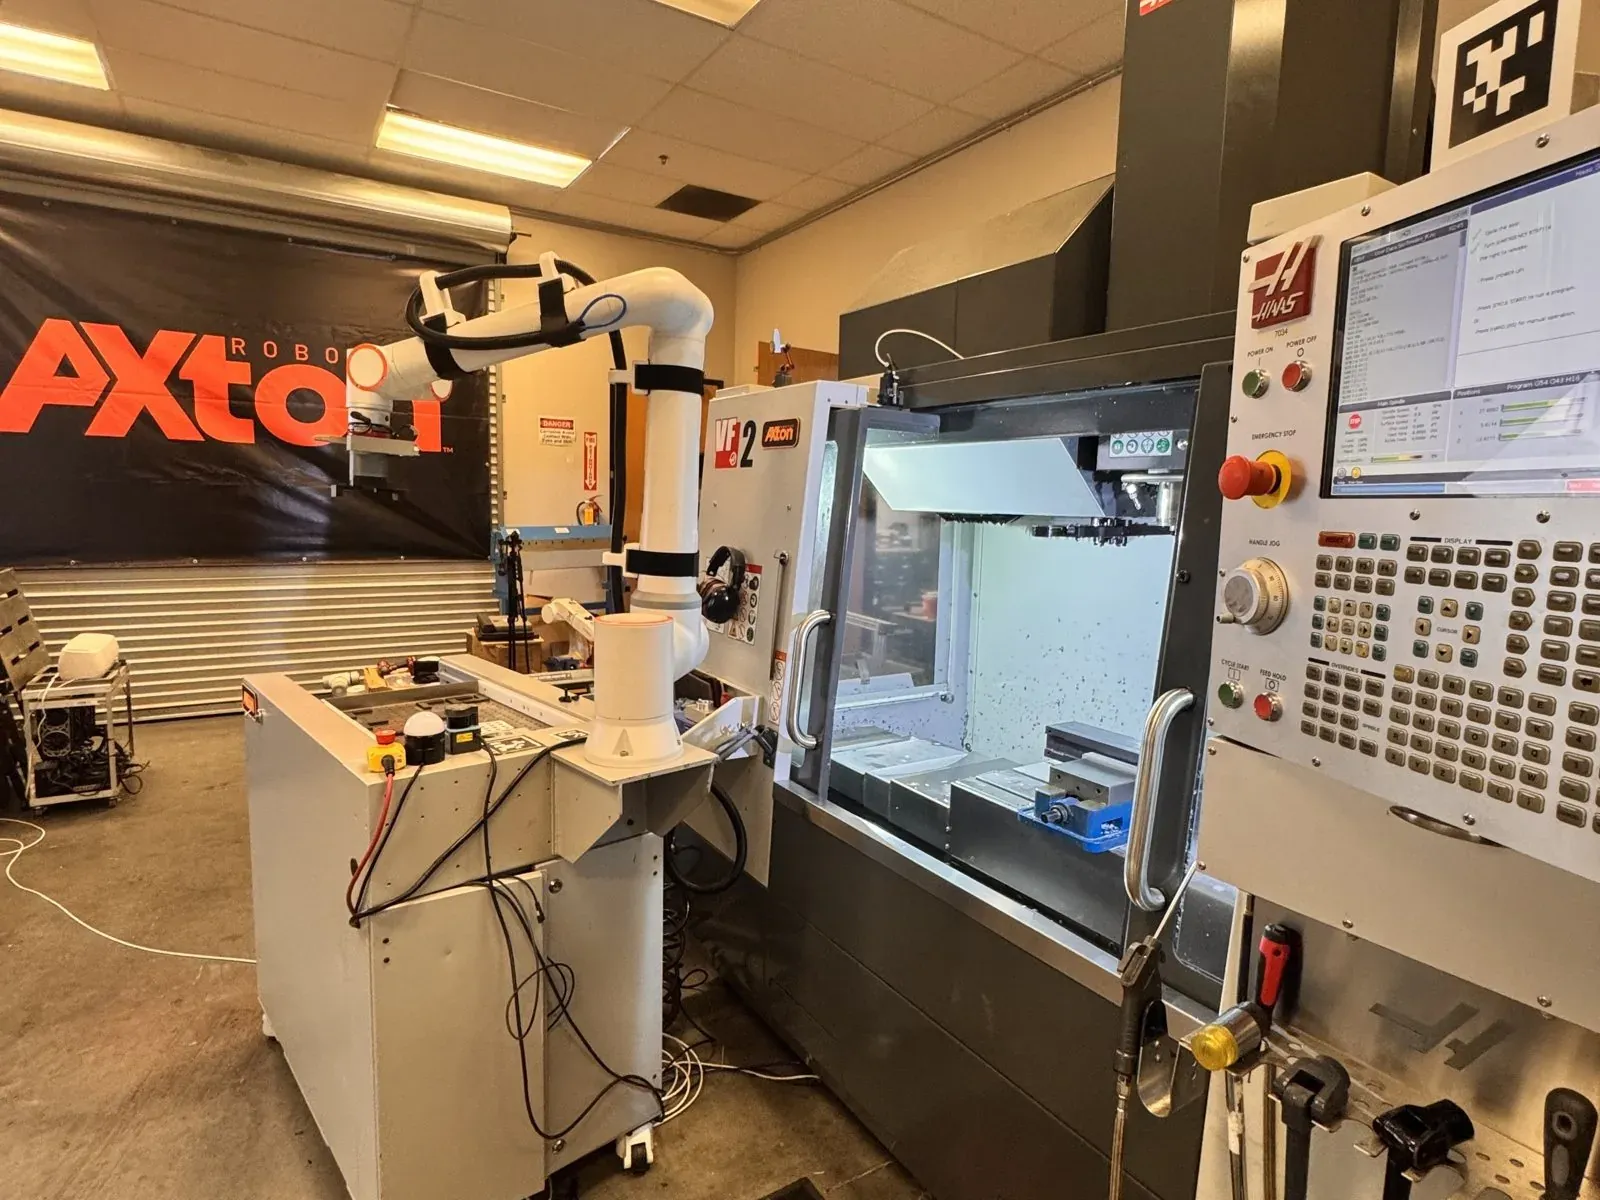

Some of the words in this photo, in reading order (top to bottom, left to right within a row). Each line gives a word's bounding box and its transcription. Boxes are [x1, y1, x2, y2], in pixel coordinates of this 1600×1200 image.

[1252, 291, 1304, 322] HAAS
[1274, 328, 1288, 338] 7034
[1286, 340, 1306, 348] POWER
[1306, 336, 1317, 344] OFF
[231, 336, 340, 366] ROBO
[1247, 349, 1264, 358] POWER
[1264, 346, 1274, 354] ON
[542, 420, 572, 428] DANGER
[1252, 431, 1282, 440] EMERGENCY
[1283, 429, 1297, 437] STOP
[715, 418, 737, 452] VF
[740, 420, 756, 468] 2
[1436, 626, 1458, 634] CURSOR
[1221, 658, 1236, 668] CYCLE
[1237, 662, 1250, 671] START
[1331, 662, 1359, 673] OVERRIDES
[1260, 668, 1271, 677] FEED
[1272, 672, 1287, 682] HOLD
